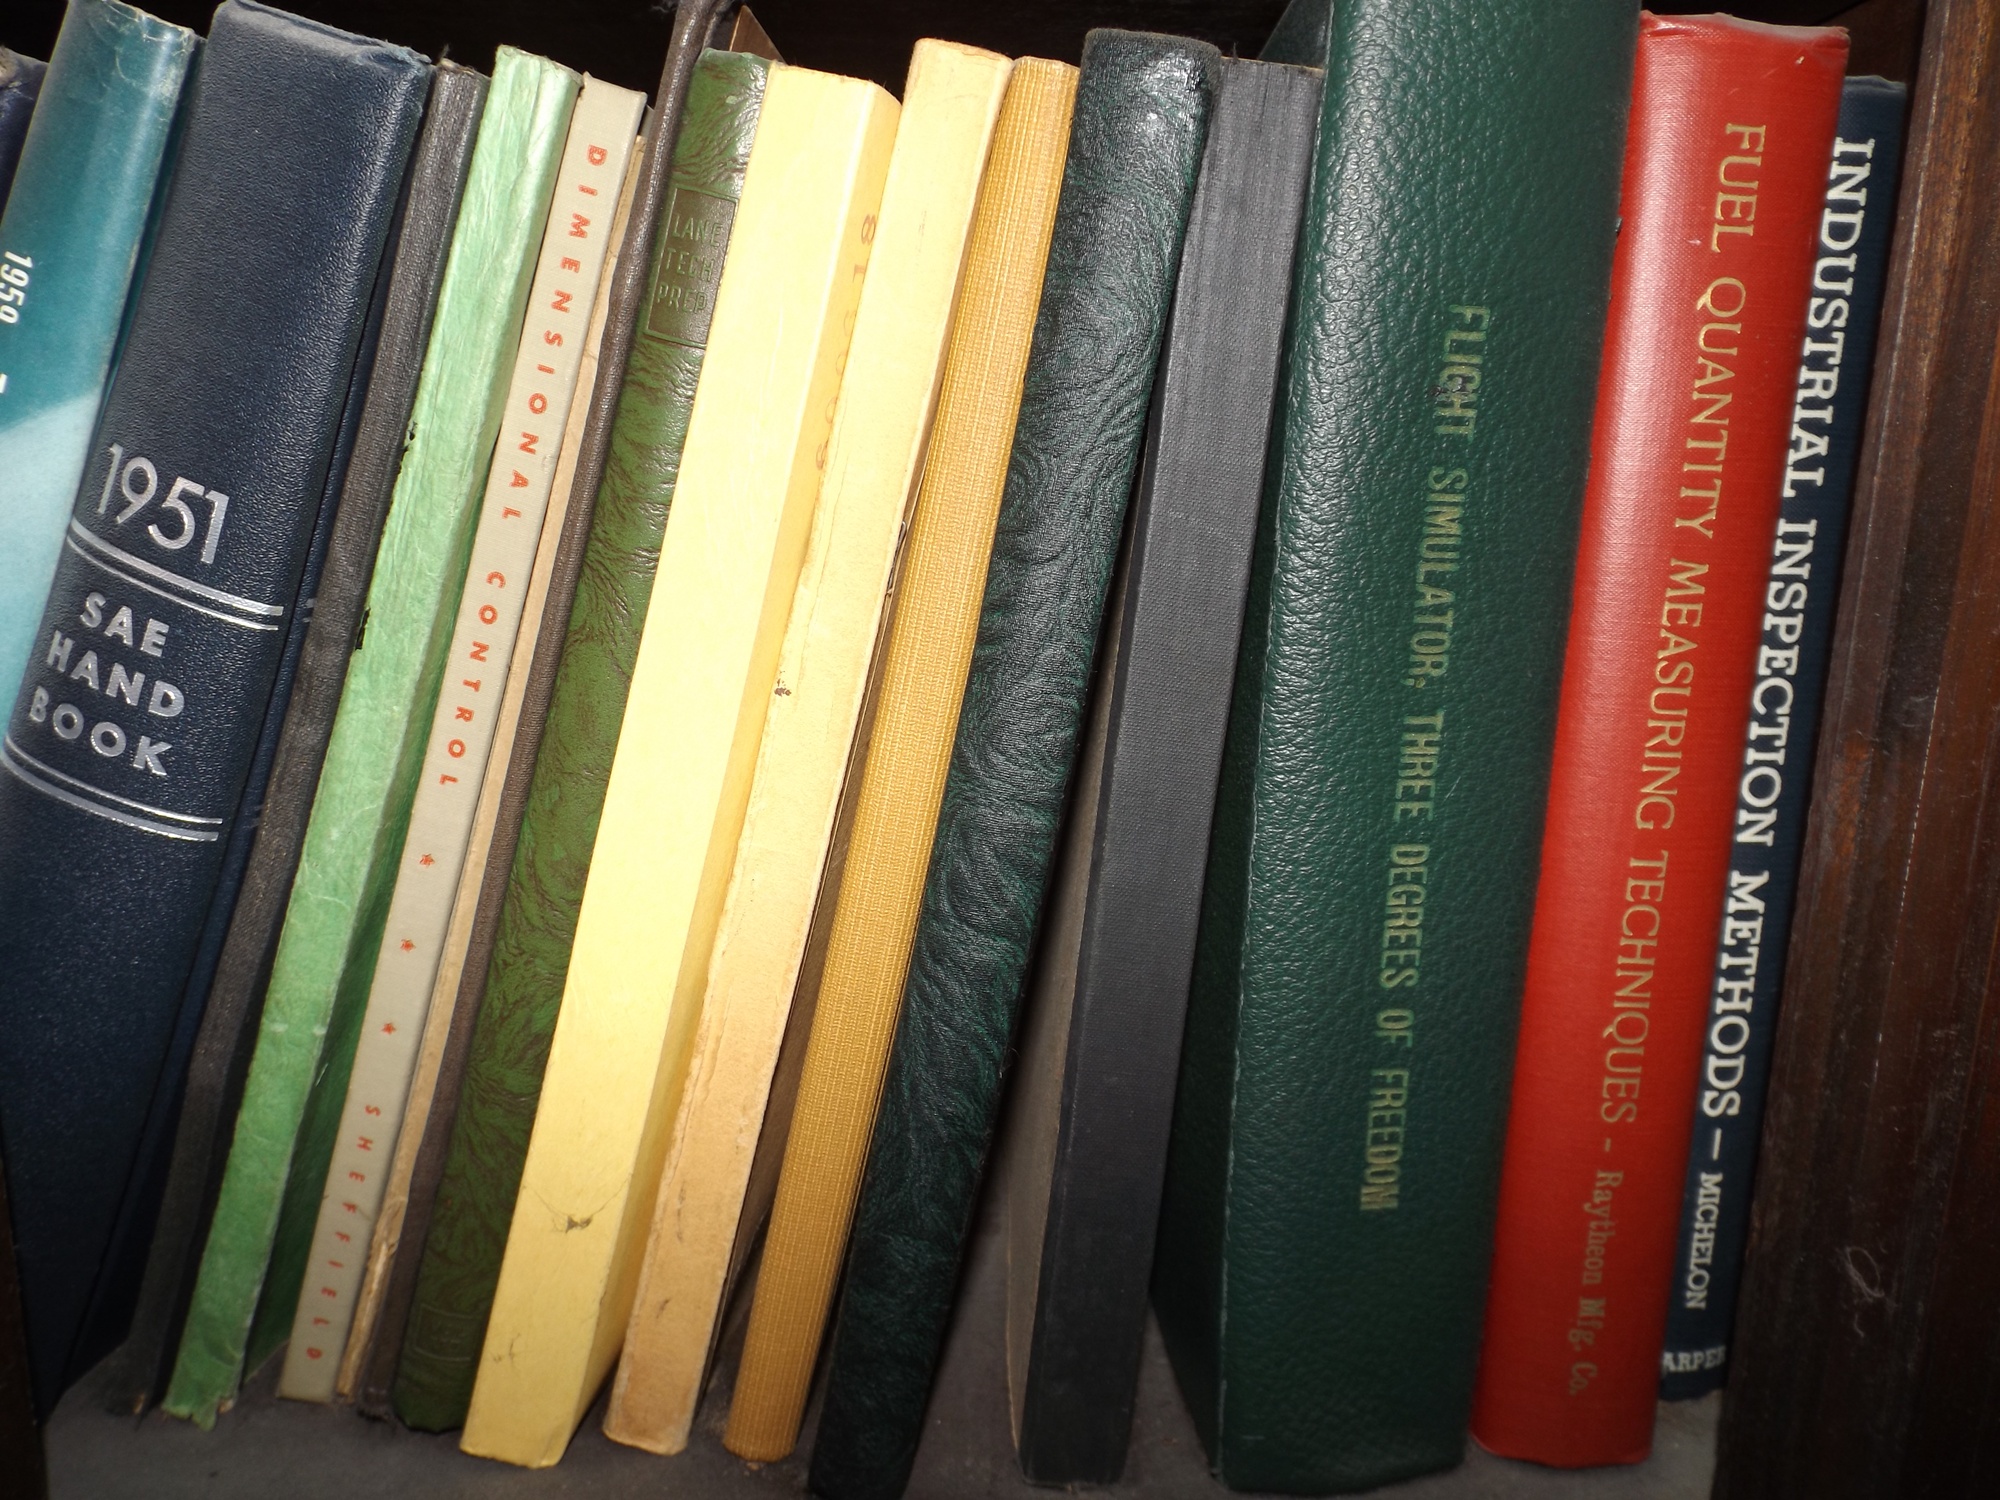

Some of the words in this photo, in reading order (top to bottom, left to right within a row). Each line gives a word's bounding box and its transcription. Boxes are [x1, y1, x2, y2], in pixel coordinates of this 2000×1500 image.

[671, 214, 723, 248] LANE
[1711, 123, 1767, 254] FUEL
[501, 143, 609, 520] DIMENSIONAL
[656, 282, 708, 314] PREP
[664, 247, 715, 283] TECH
[1782, 136, 1875, 498] INDUSTRIAL
[1433, 303, 1491, 442] FLIGHT
[1675, 276, 1747, 540] QUANTITY
[97, 443, 230, 565] 1951
[46, 630, 186, 718] HAND
[79, 592, 171, 658] SAE
[439, 570, 507, 787] CONTROL
[1736, 517, 1818, 847] INSPECTION
[29, 685, 172, 777] BOOK
[1636, 557, 1710, 831] MEASURING
[1395, 708, 1445, 822] THREE
[1379, 843, 1431, 991] DEGREES
[1376, 1008, 1414, 1048] OF
[1601, 849, 1669, 1125] TECHNIQUES
[1703, 869, 1770, 1117] METHODS
[1359, 1069, 1410, 1212] FREEDOM
[306, 1104, 381, 1361] SHEFFIELD
[1583, 1169, 1624, 1285] Raytheon
[1686, 1171, 1724, 1309] MICHELON
[1568, 1297, 1606, 1352] Mfg.
[1569, 1362, 1598, 1397] Co.
